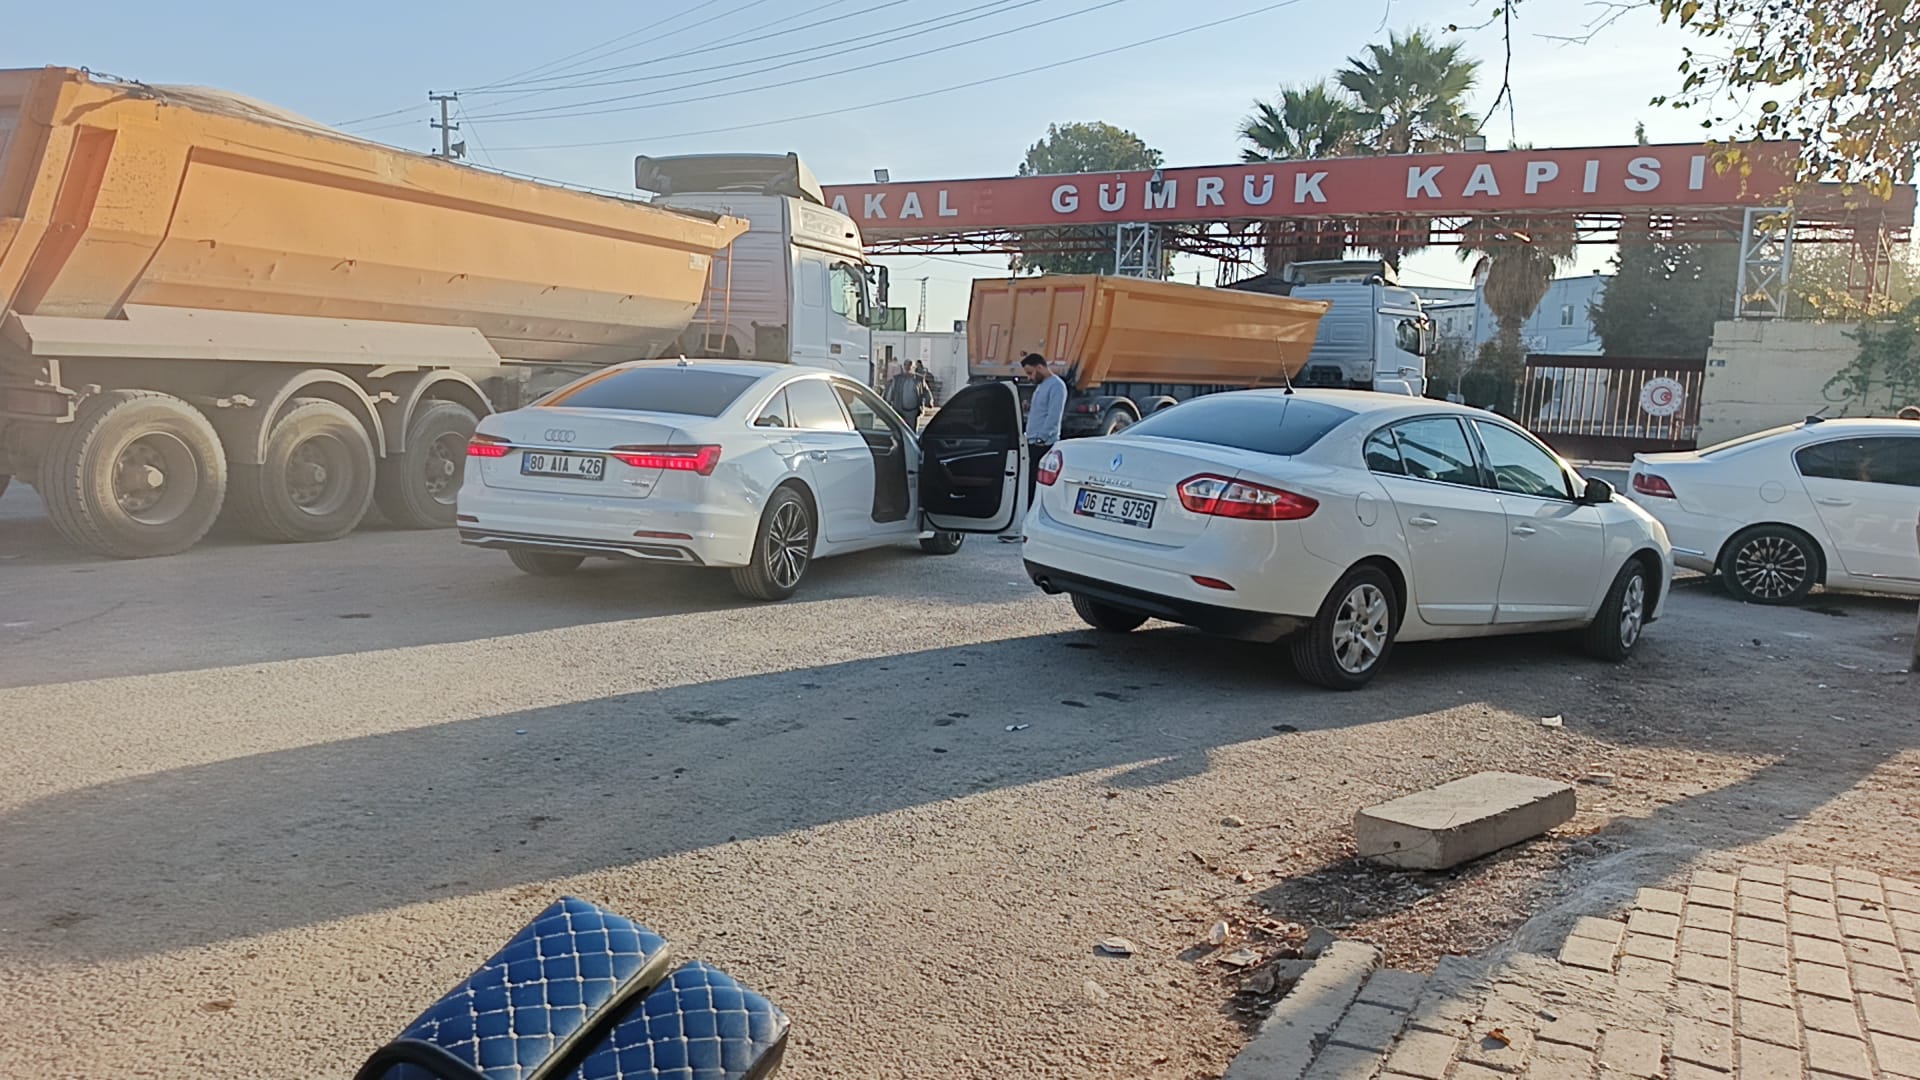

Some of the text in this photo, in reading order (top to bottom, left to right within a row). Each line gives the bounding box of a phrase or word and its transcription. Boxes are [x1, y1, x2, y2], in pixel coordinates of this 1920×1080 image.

[1406, 155, 1705, 198] KAPISI
[529, 455, 545, 470] 80
[579, 458, 601, 474] 426
[1083, 493, 1152, 520] 06 EE 9756
